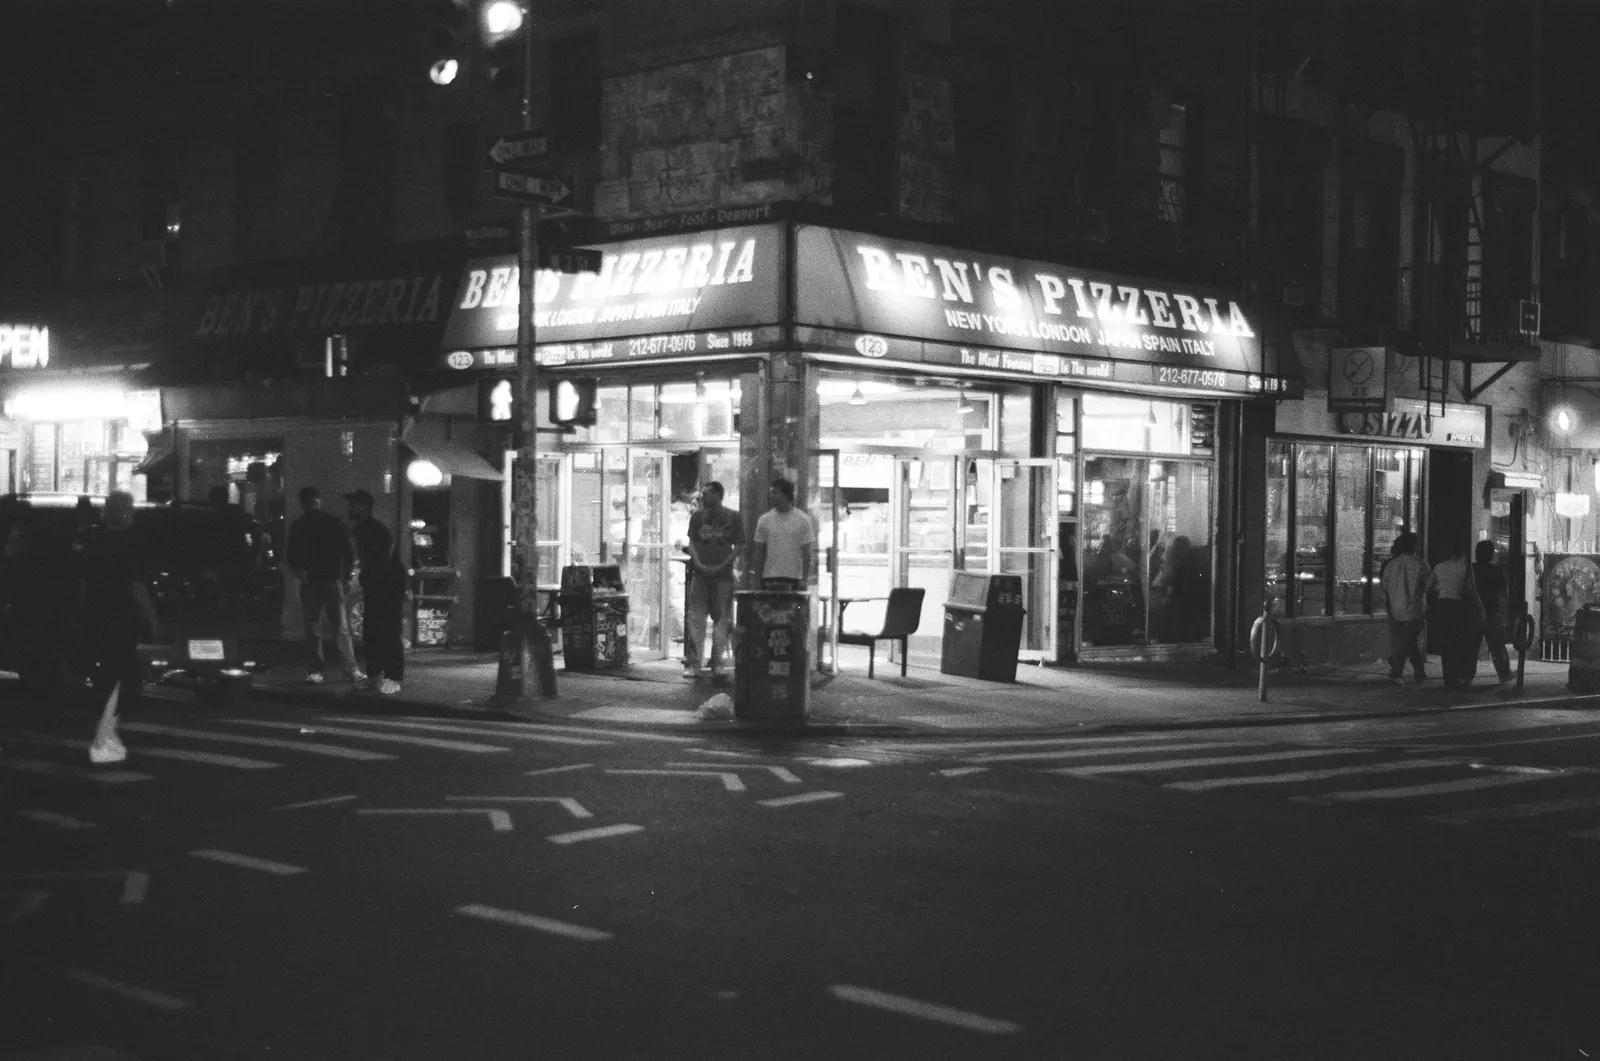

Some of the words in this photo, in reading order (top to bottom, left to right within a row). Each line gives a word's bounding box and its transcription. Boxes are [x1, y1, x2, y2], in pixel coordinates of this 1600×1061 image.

[680, 210, 708, 228] Food
[718, 204, 771, 223] Dessert
[460, 267, 561, 309] BENS
[570, 238, 756, 301] PIZZERIA
[857, 245, 1022, 313] BEN'S
[1035, 272, 1255, 339] PIZZERIA
[288, 275, 443, 334] PIZZERIA
[668, 297, 701, 317] ITALY
[944, 308, 982, 332] NEW
[982, 317, 1029, 338] YORK
[1030, 320, 1091, 345] LONDON
[1097, 328, 1143, 351] JAPAN
[1142, 335, 1181, 354] SPAIN
[1180, 338, 1216, 357] ITALY
[629, 333, 696, 356] 212-677-0976
[861, 339, 884, 355] 123
[452, 352, 470, 367] 123
[960, 349, 975, 365] The
[978, 351, 999, 368] Most
[1070, 360, 1084, 376] The
[1159, 366, 1226, 387] 212-677-0976
[1270, 377, 1287, 391] 196
